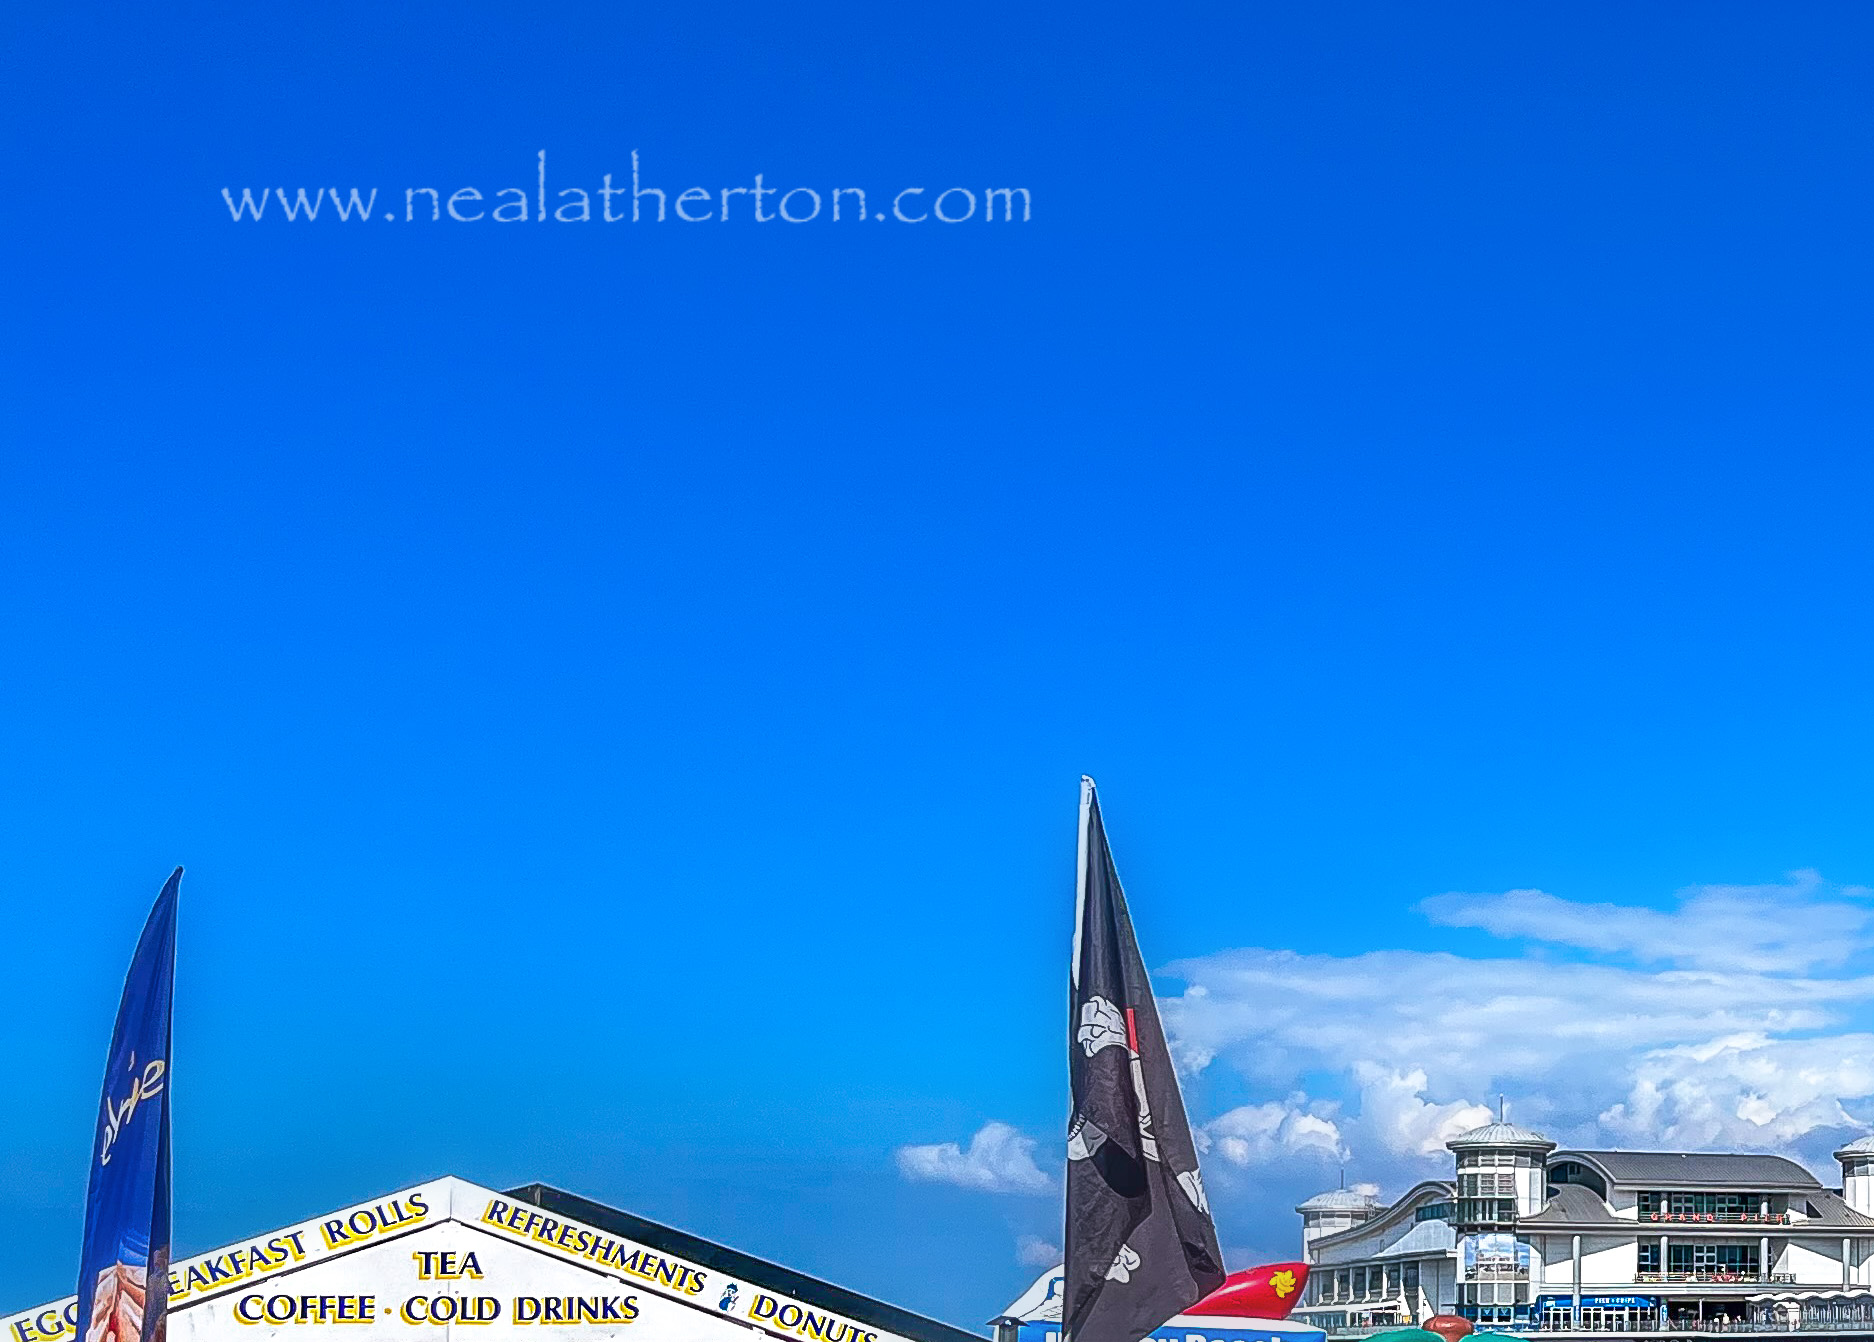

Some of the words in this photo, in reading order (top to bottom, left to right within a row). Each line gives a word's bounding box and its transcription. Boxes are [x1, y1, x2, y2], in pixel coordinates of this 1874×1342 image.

[320, 1192, 430, 1250] ROLLS
[412, 1251, 485, 1280] TEA
[481, 1199, 708, 1296] REFRESHMENTS
[233, 1294, 376, 1325] COFFEE
[400, 1294, 501, 1325] COLD
[512, 1294, 640, 1325] DRINKS
